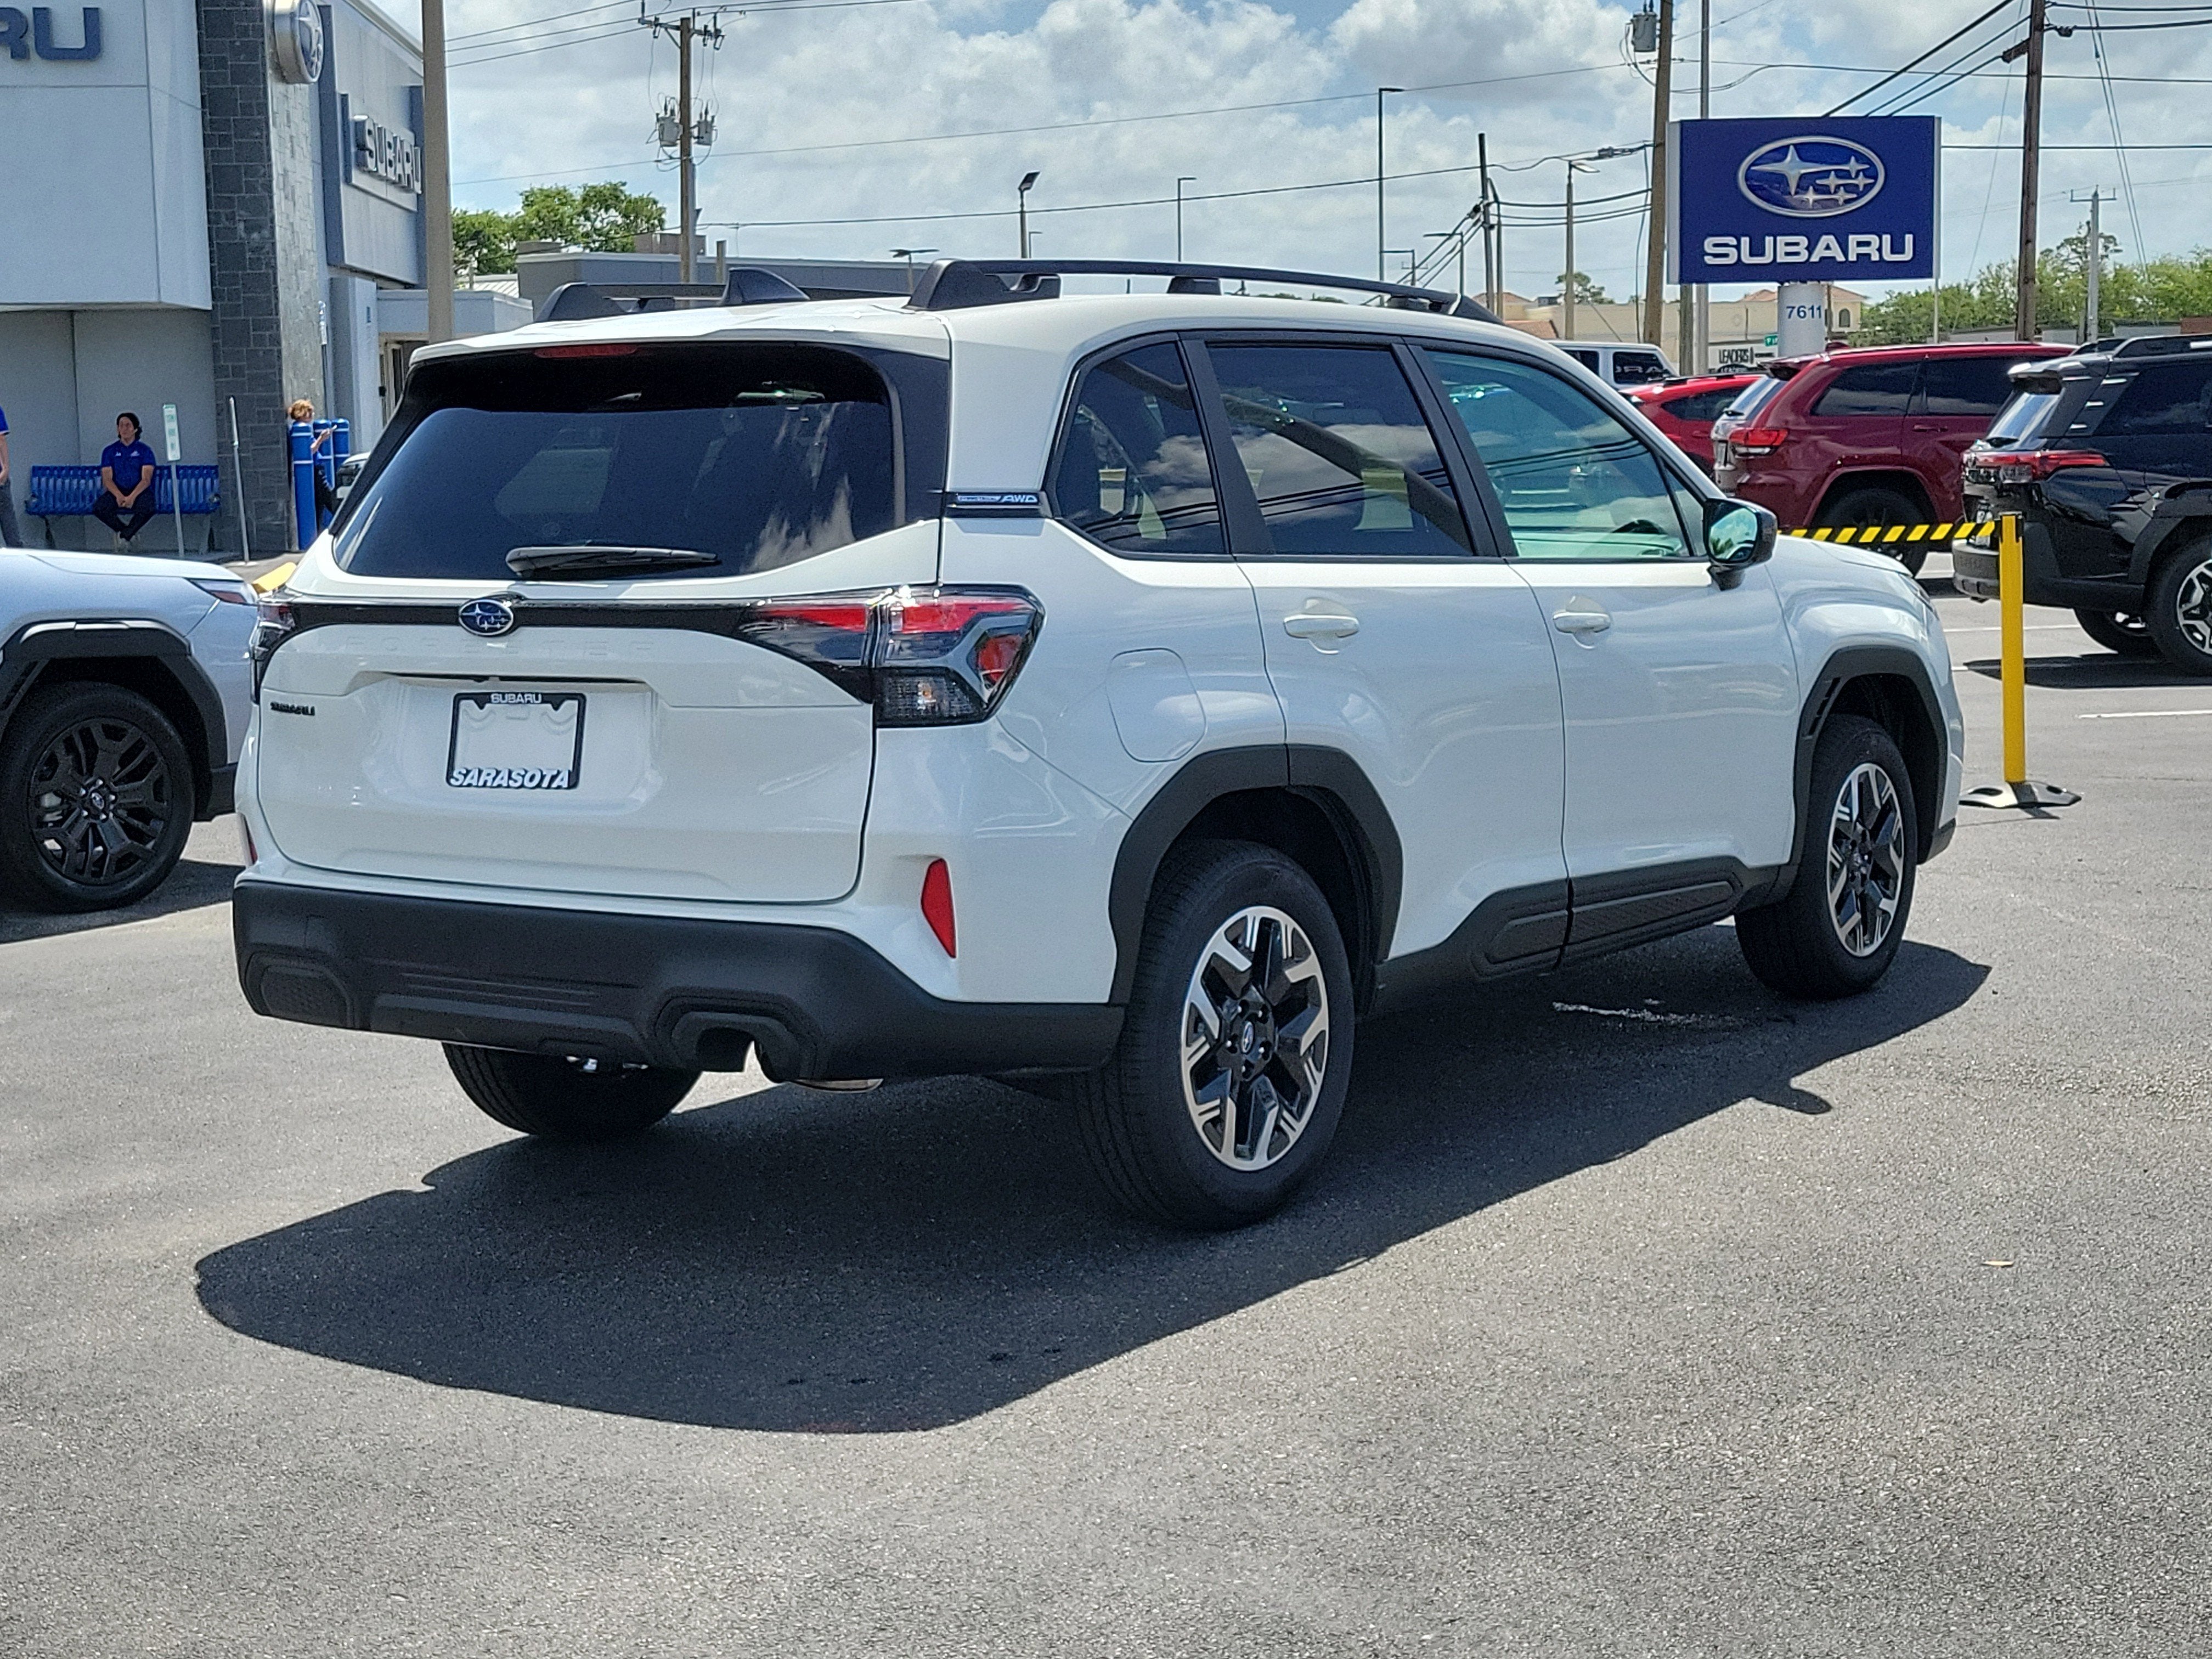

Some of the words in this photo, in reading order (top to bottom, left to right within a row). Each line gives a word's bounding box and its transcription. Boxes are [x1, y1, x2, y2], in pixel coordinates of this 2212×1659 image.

[354, 116, 422, 194] SUBARU
[1703, 234, 1914, 264] SUBARU
[1786, 304, 1822, 319] 7611
[1001, 494, 1038, 503] AWD
[491, 693, 542, 704] SUBARU
[450, 768, 569, 788] SARASOTA
